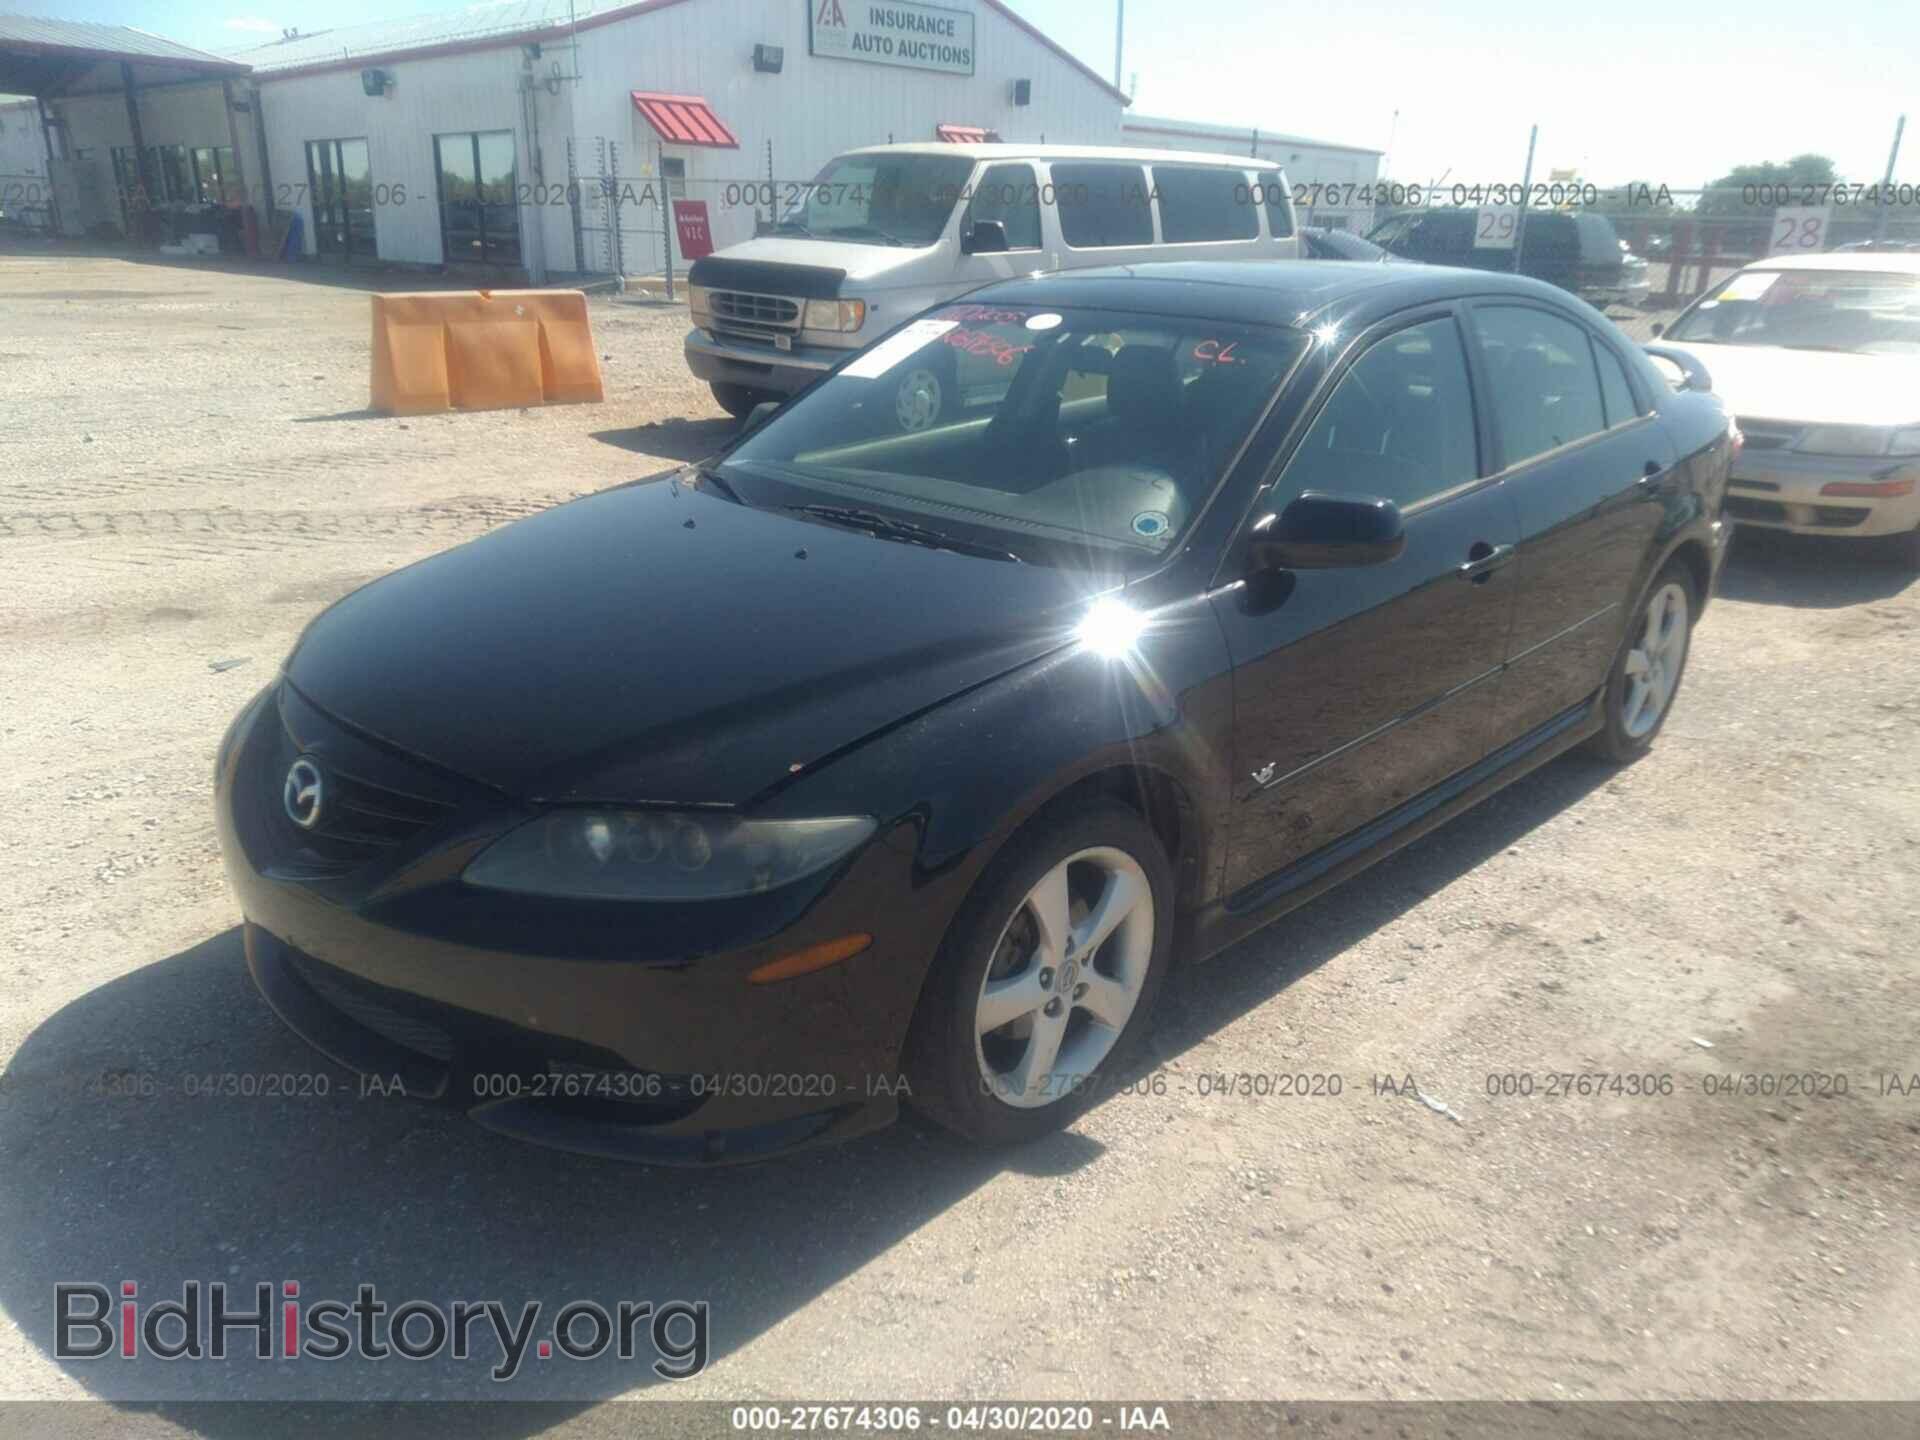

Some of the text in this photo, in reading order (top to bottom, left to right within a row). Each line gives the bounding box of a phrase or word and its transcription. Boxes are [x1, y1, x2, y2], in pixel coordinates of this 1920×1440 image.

[869, 7, 955, 37] INSURANCE
[852, 32, 971, 65] AUTO AUCTIONS
[1480, 212, 1515, 239] 29
[1776, 217, 1823, 248] 28
